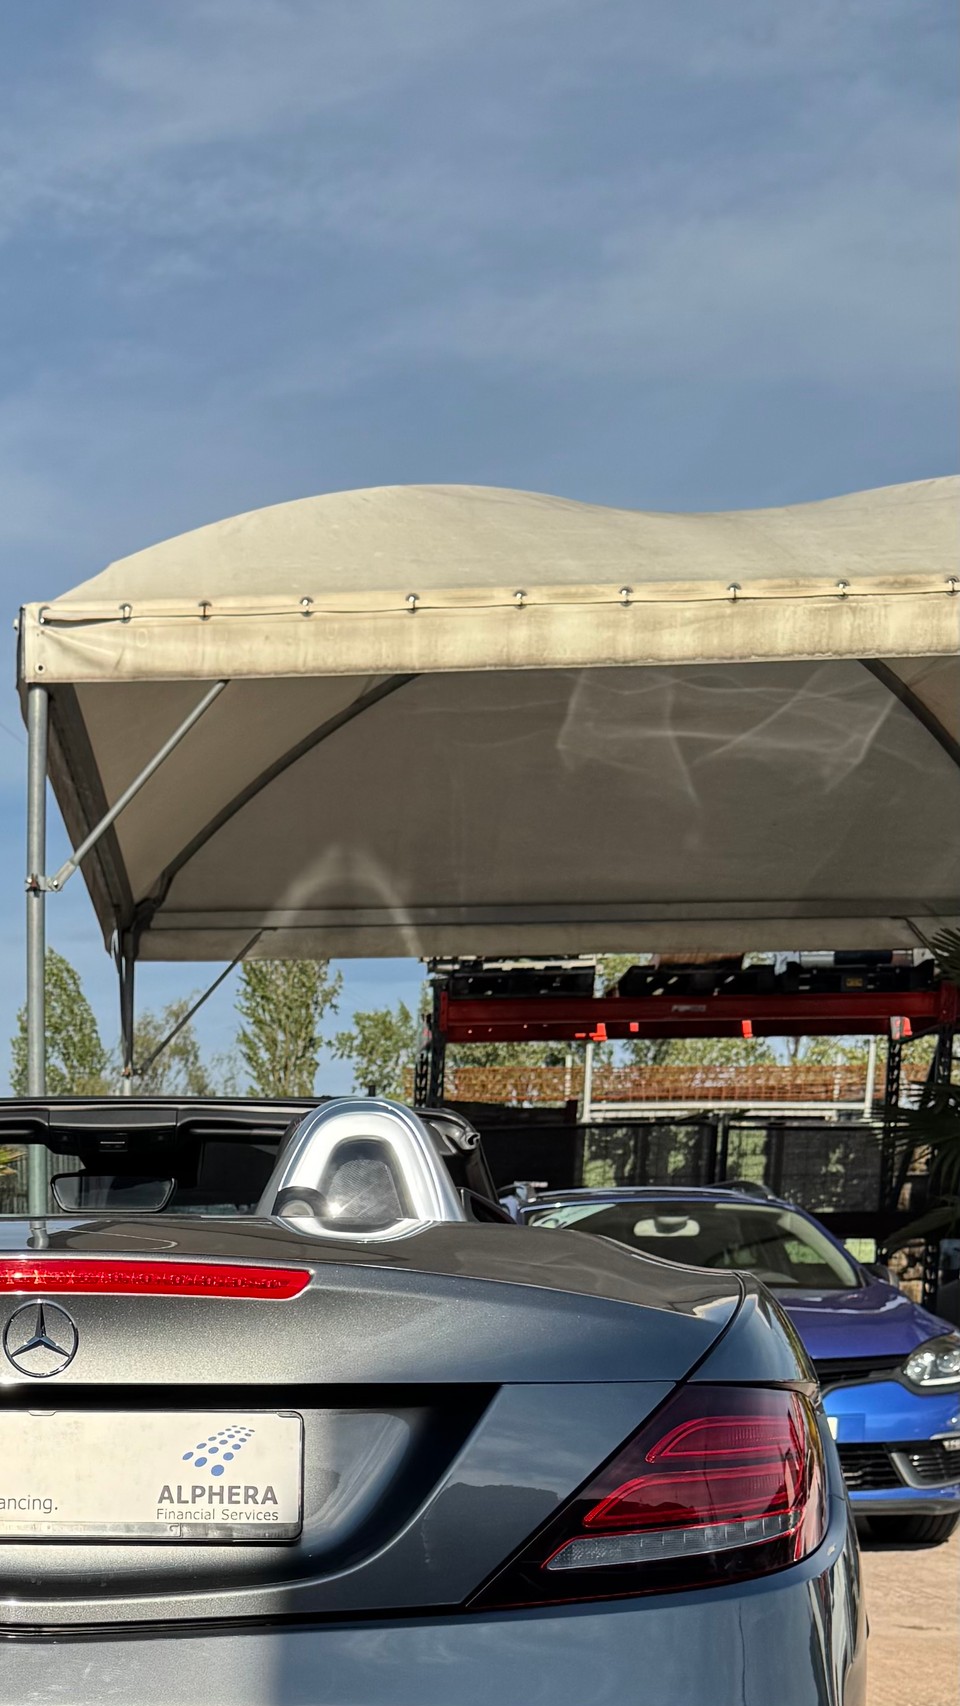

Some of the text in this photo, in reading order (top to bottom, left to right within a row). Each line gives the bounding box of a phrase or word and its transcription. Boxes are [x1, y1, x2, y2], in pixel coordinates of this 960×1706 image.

[157, 1485, 279, 1505] ALPHERA
[156, 1508, 279, 1521] Financial Services
